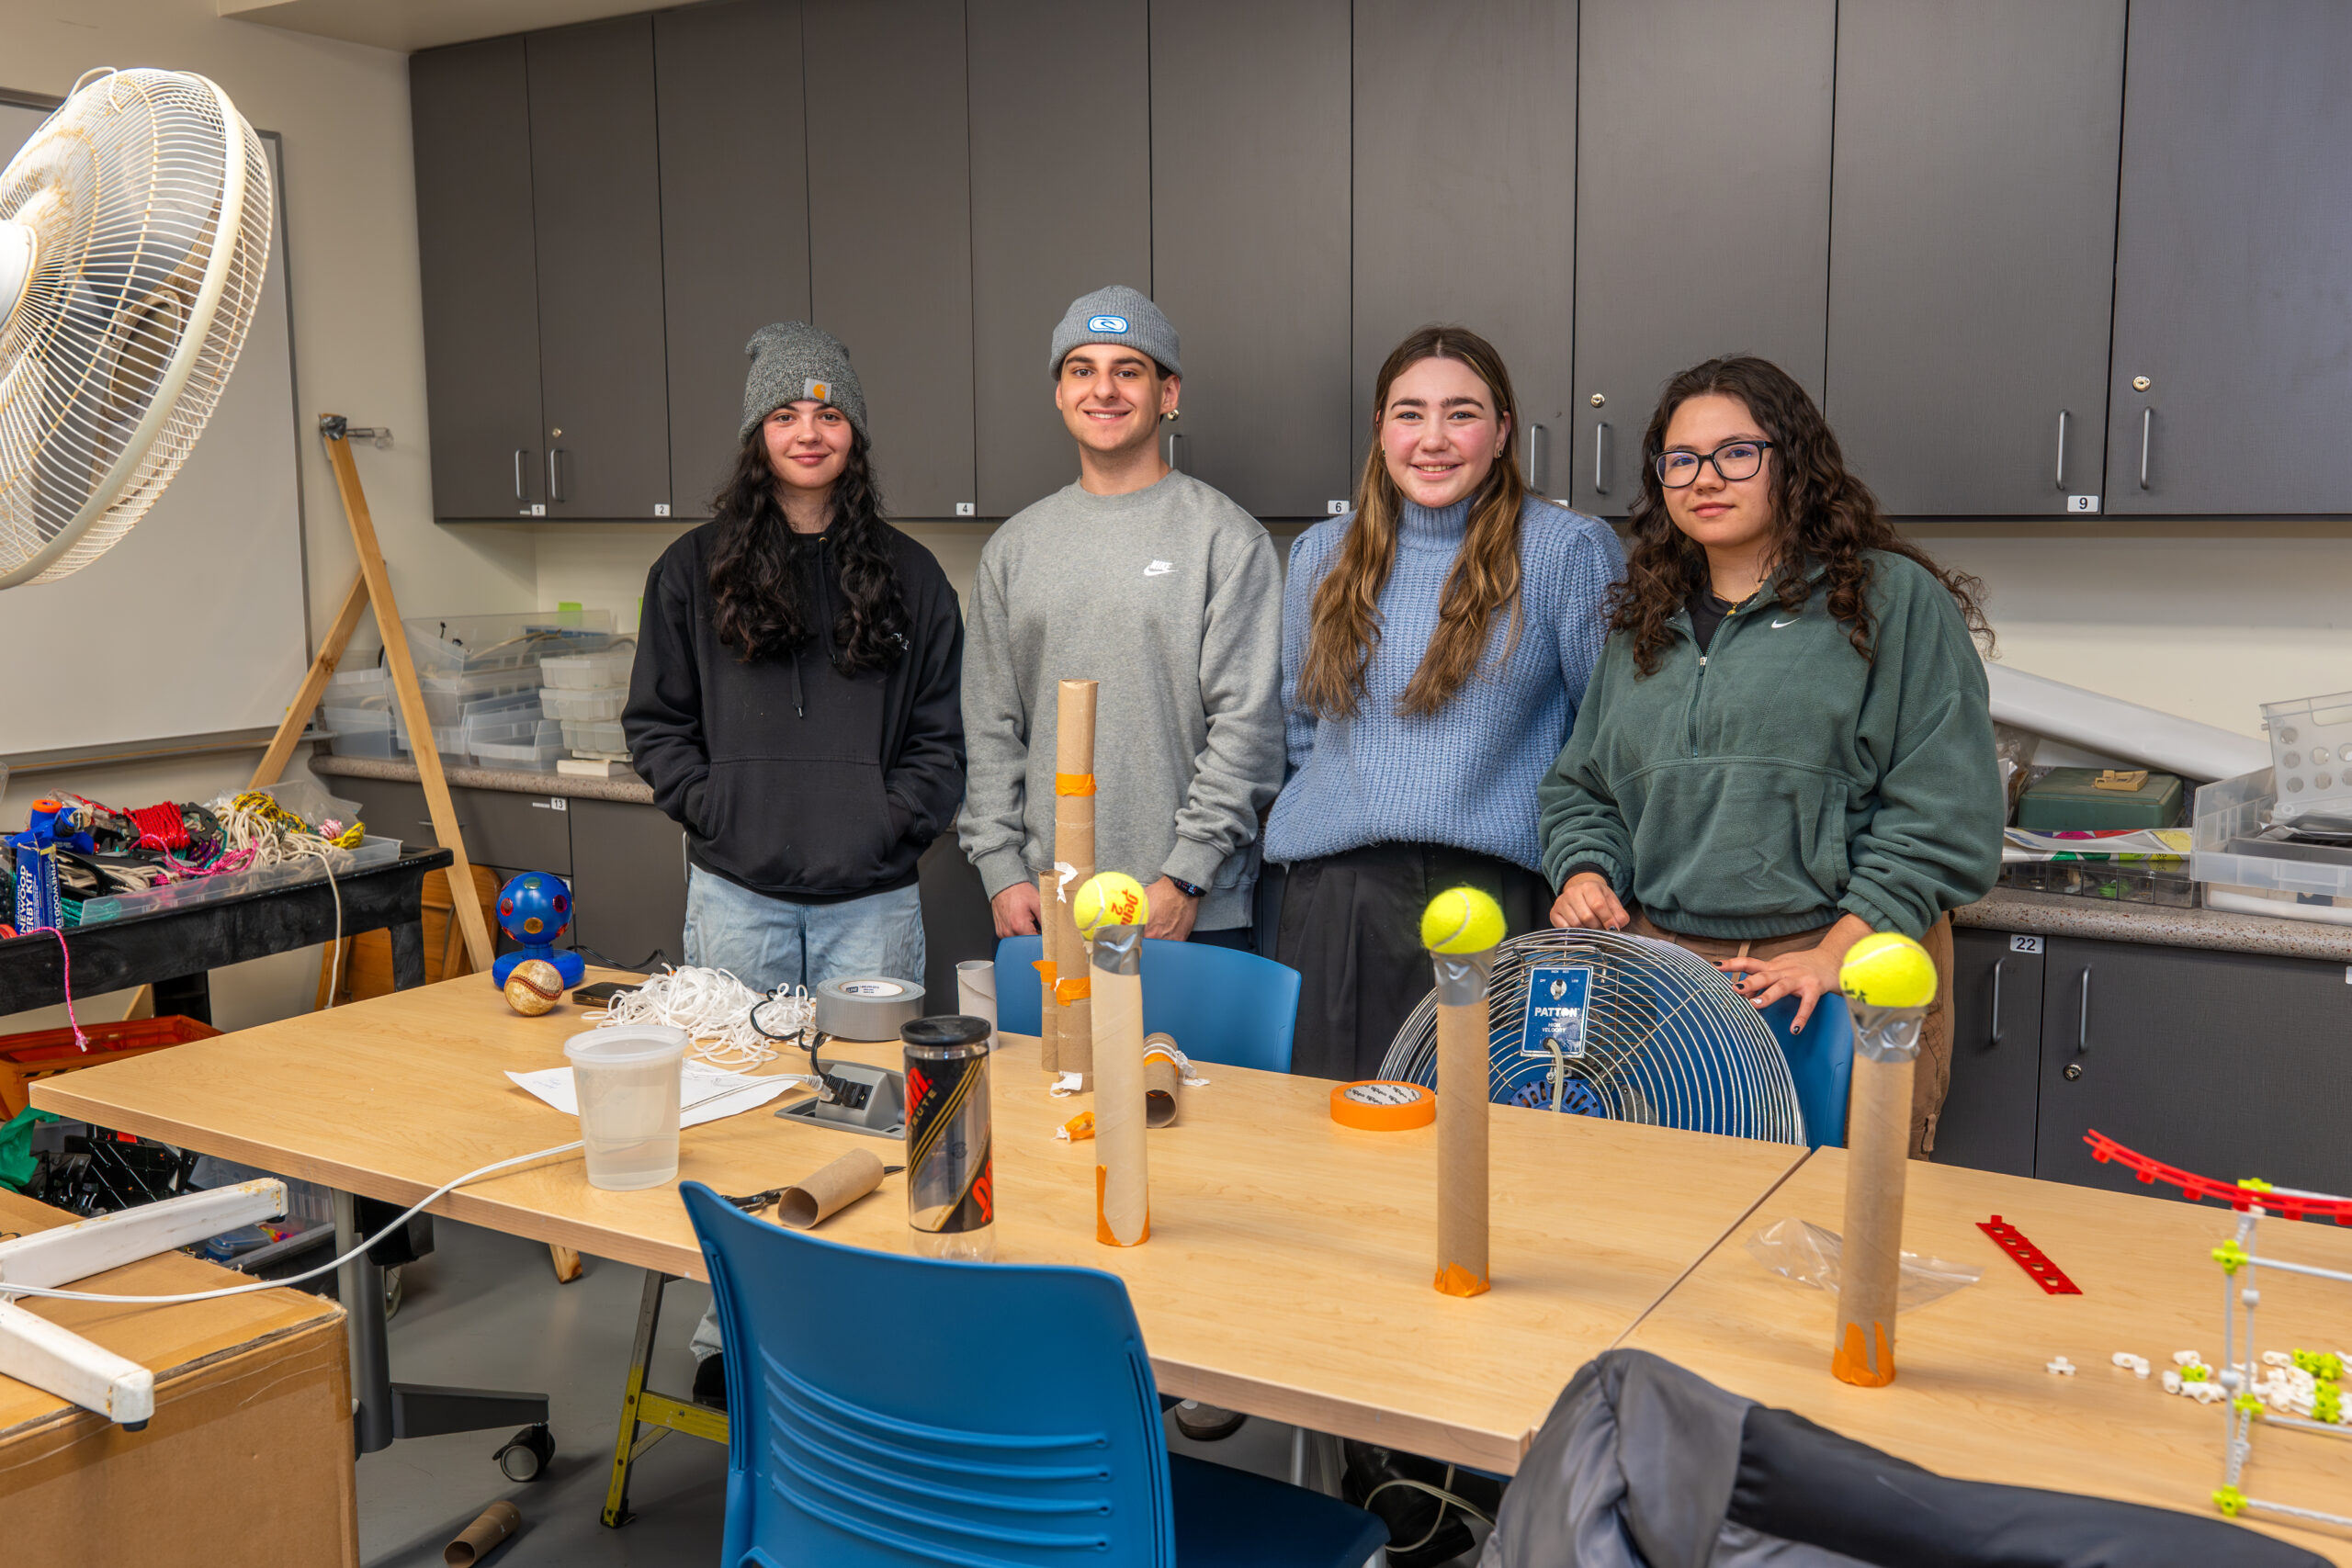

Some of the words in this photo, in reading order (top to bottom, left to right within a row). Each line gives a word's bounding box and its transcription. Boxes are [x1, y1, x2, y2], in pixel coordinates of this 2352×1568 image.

[962, 503, 968, 513] 4
[1335, 502, 1342, 513] 6
[2079, 497, 2088, 510] 9
[660, 505, 664, 514] 2
[1149, 559, 1173, 570] NIKE
[554, 799, 563, 808] 13
[51, 863, 61, 916] PINEWOOD
[1111, 902, 1124, 916] 2
[26, 897, 34, 933] ERBY
[2016, 937, 2036, 951] 22
[1534, 1007, 1577, 1017] PATTON
